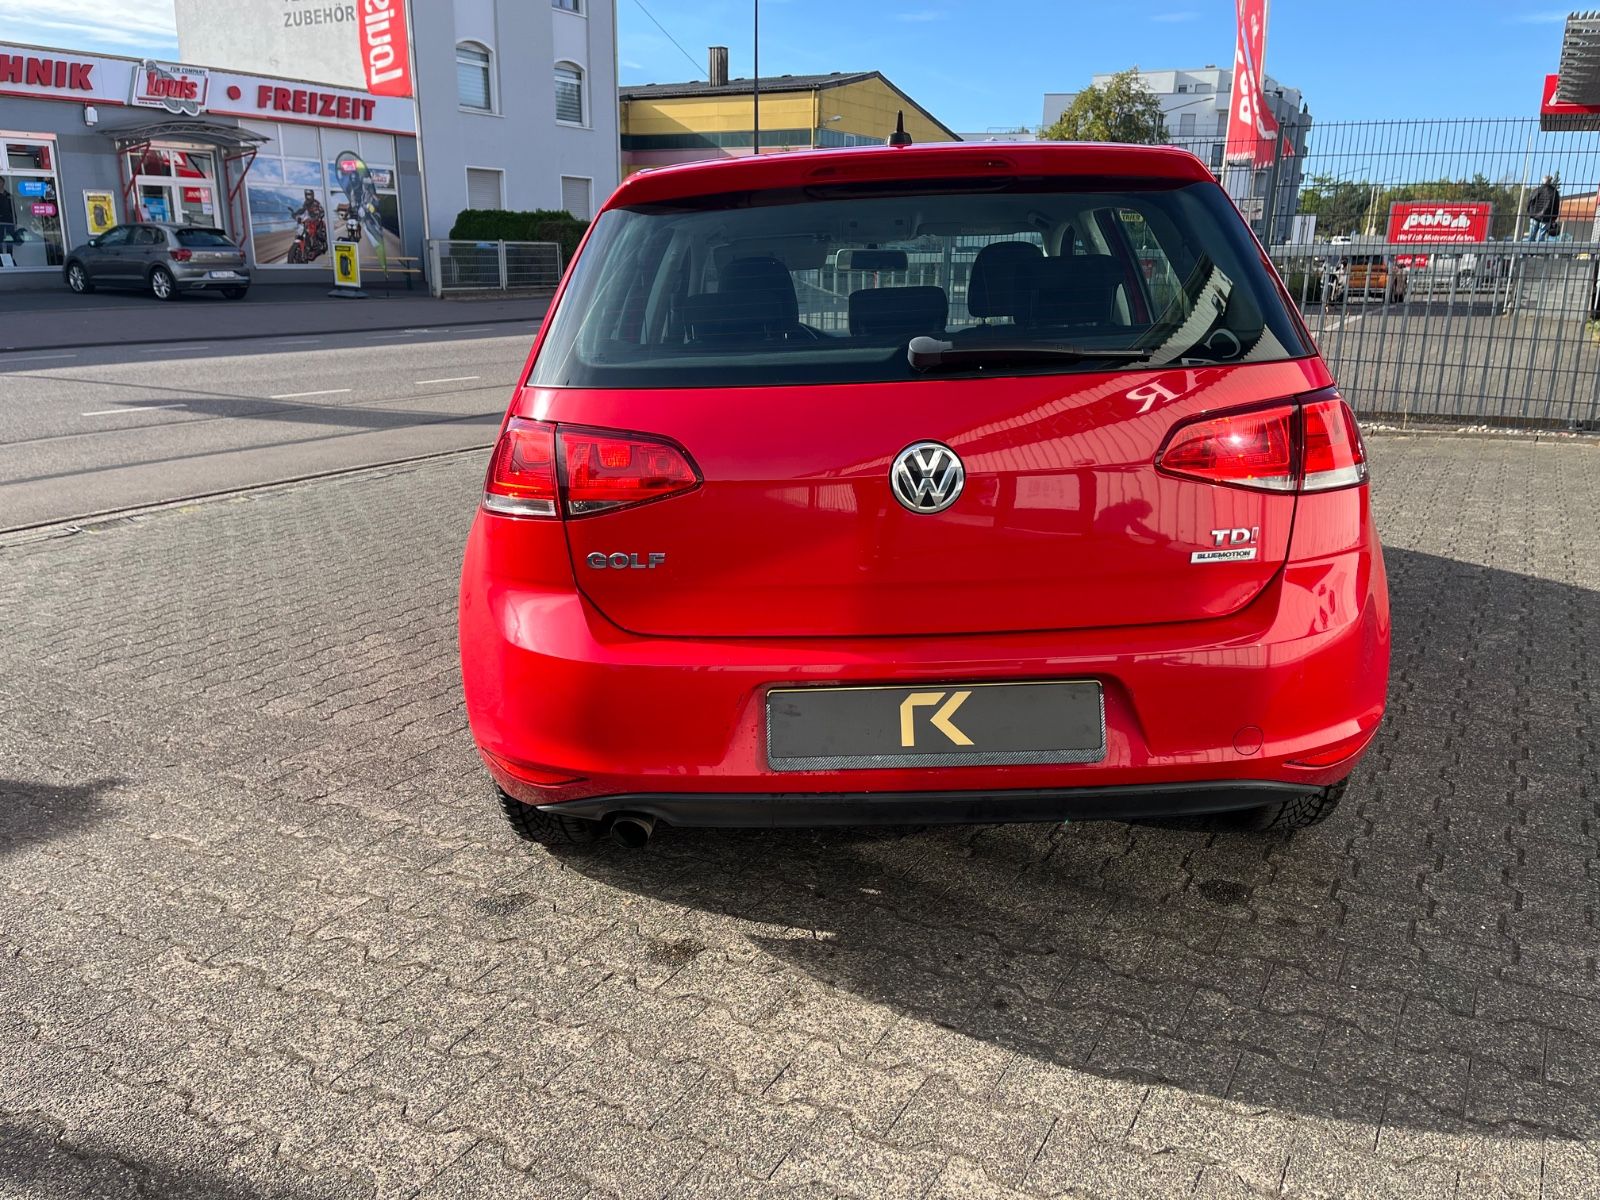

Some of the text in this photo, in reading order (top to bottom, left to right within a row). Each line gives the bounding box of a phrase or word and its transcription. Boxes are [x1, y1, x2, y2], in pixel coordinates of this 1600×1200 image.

[284, 3, 356, 28] ZUBEHÖR
[146, 70, 198, 99] Louis
[257, 84, 377, 122] FREIZEIT
[898, 447, 959, 509] VW
[1211, 526, 1259, 546] TDI
[586, 551, 666, 569] GOLF
[1197, 550, 1251, 559] BLUEMOTION
